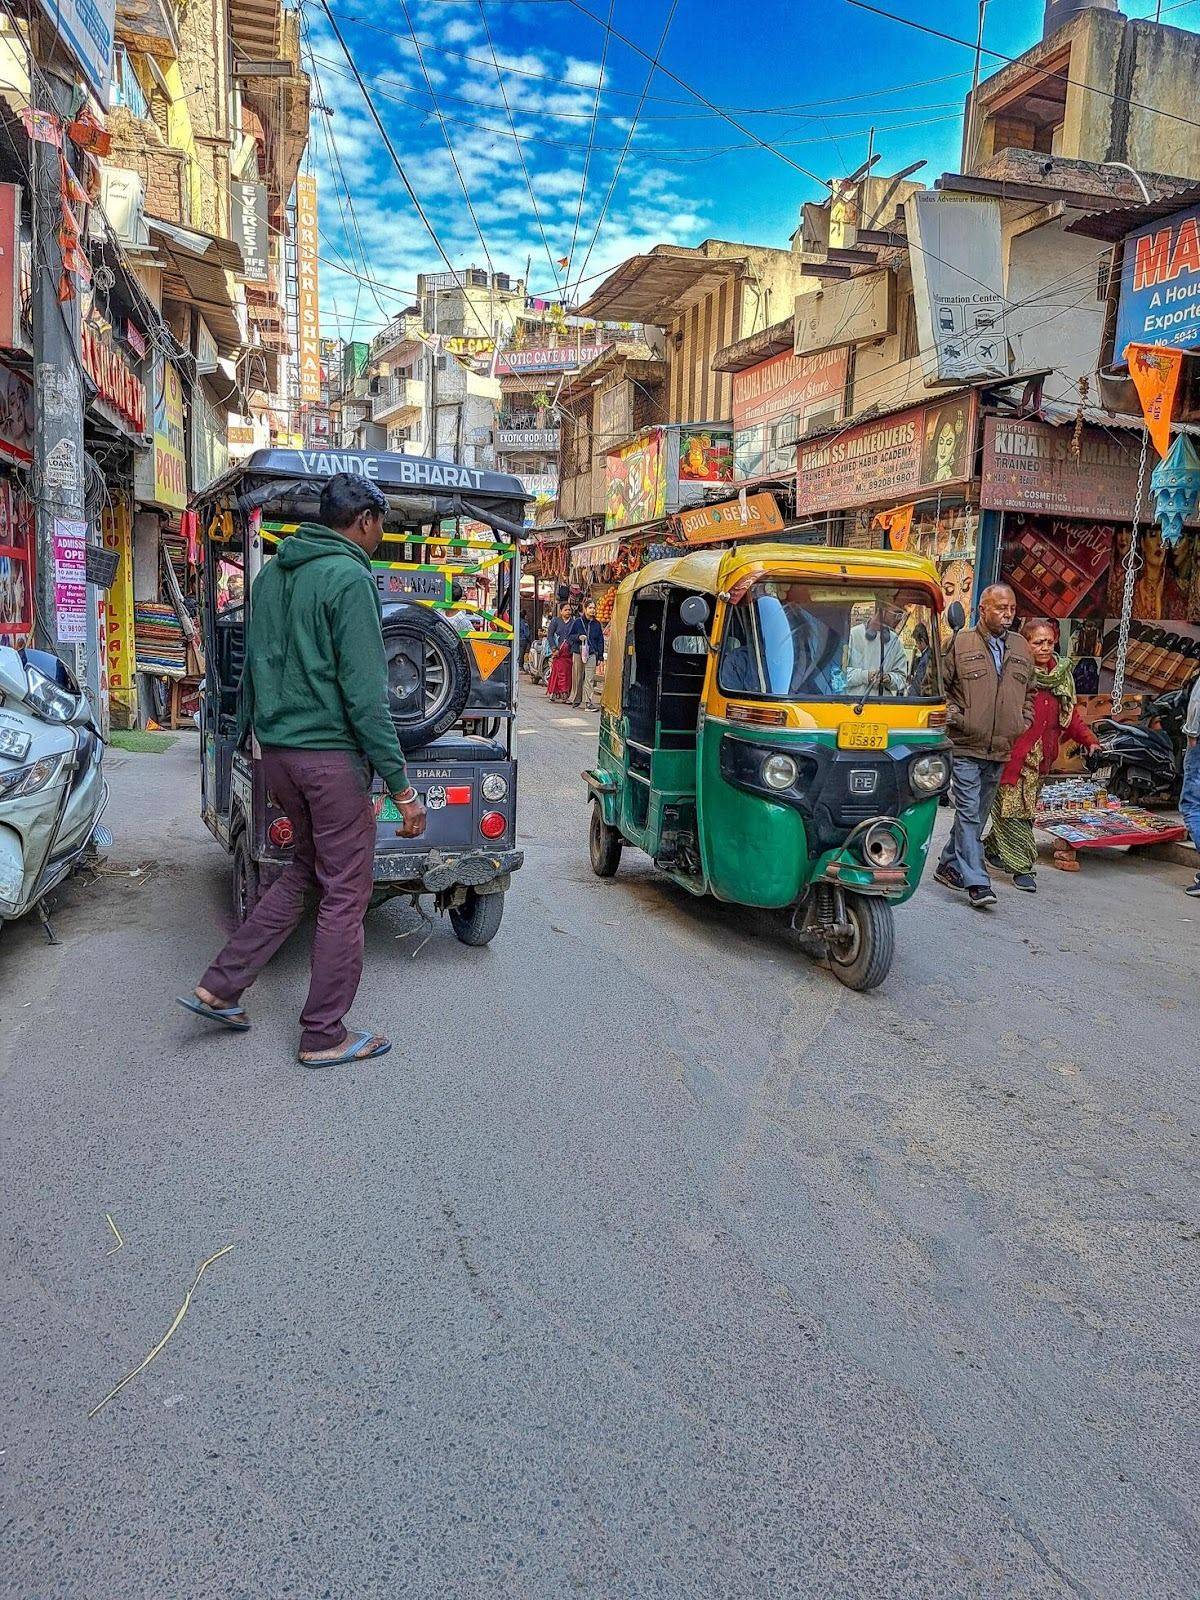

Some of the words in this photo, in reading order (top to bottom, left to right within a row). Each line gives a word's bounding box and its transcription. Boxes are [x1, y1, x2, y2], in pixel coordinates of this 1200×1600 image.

[241, 185, 258, 256] EVEREST
[244, 257, 266, 267] AFE
[1149, 292, 1162, 309] A
[534, 349, 559, 364] CAFE
[745, 403, 765, 420] Home
[806, 380, 829, 398] Store
[500, 433, 523, 442] EXOTIC
[544, 433, 558, 442] TOP
[832, 443, 846, 464] SS
[847, 421, 916, 460] MAKEOVERS
[994, 431, 1051, 459] KIRAN
[880, 447, 913, 464] ACADEMY
[994, 456, 1040, 472] TRAINED
[298, 451, 379, 480] VANDE
[401, 461, 485, 490] BHARAT
[1023, 490, 1068, 502] COSMETICS
[685, 512, 712, 533] SOUL
[416, 769, 452, 778] BHARAT
